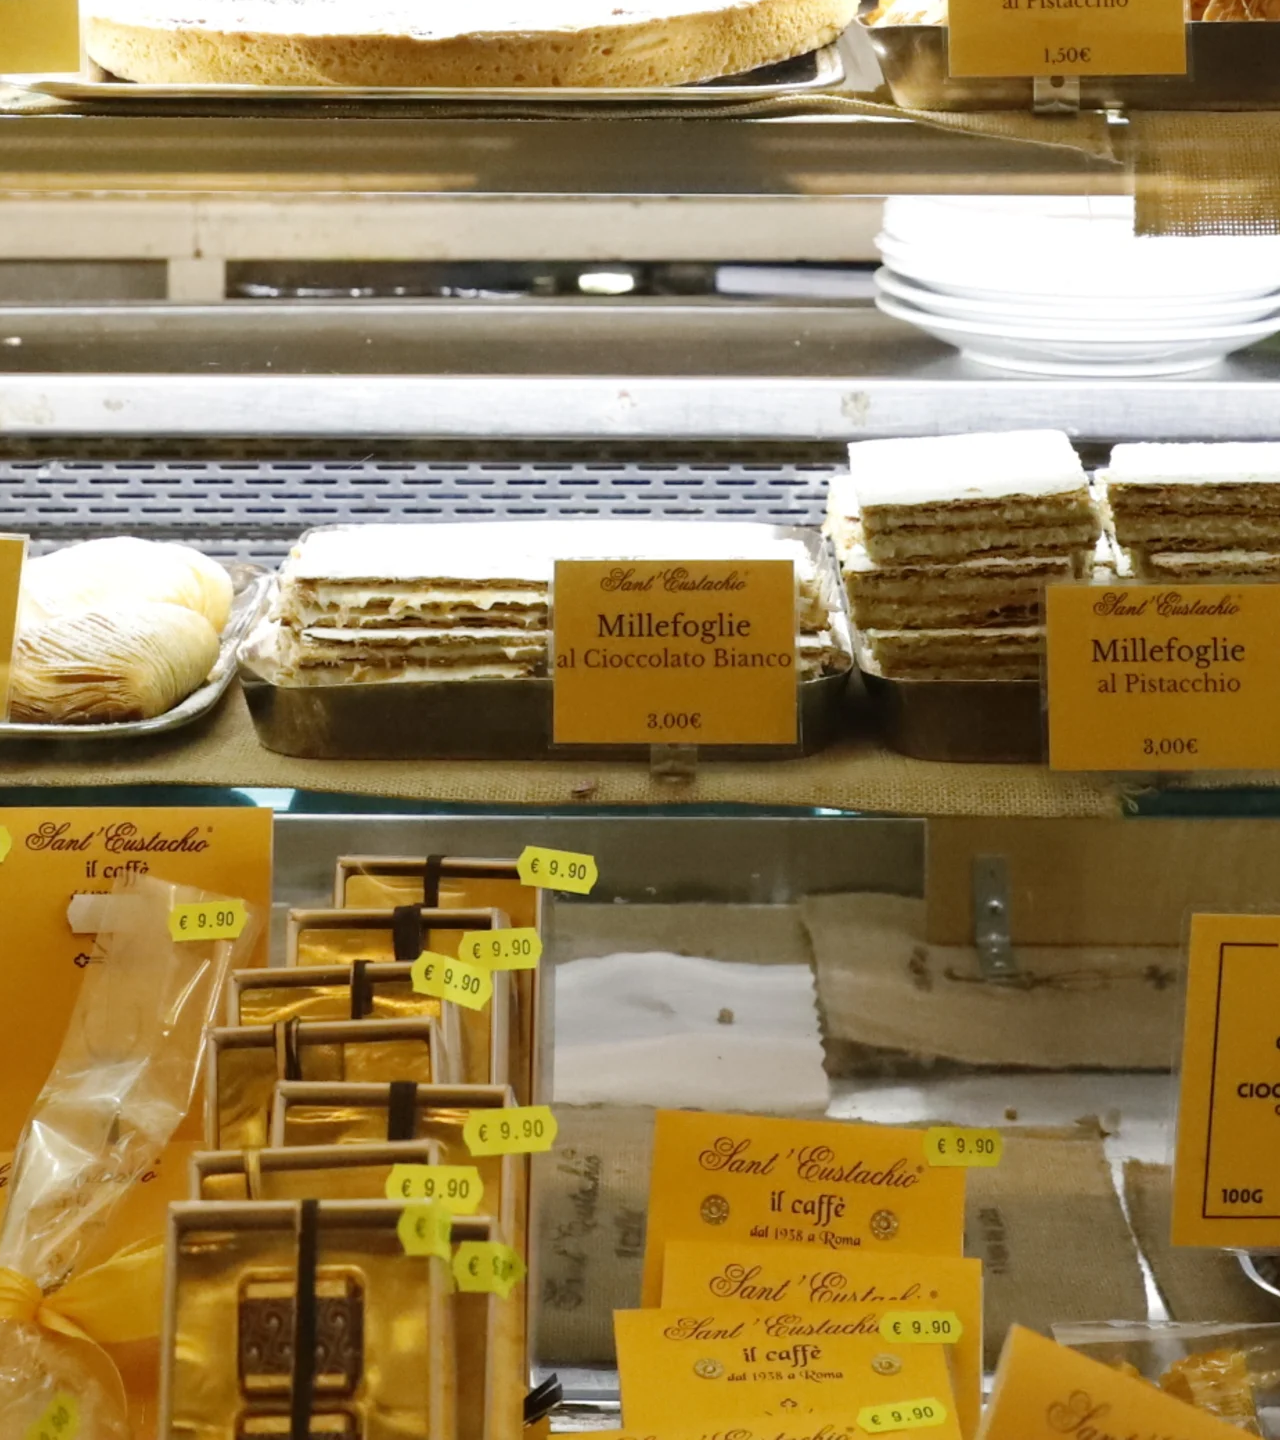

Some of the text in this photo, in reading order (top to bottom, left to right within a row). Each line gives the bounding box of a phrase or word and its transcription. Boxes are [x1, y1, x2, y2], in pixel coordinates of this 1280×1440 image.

[1044, 47, 1091, 64] 1,50€
[596, 612, 751, 644] Millefoglie
[556, 648, 793, 668] al Cioccolato Bianco
[1091, 637, 1245, 669] Millefoglie
[1098, 672, 1241, 694] al Pistacchio
[647, 712, 703, 730] 3,00€
[1143, 738, 1198, 756] 3,00€
[548, 860, 588, 880] 9.90
[197, 910, 236, 929] 9.90
[492, 939, 531, 958] 9.90
[442, 968, 480, 994] 9.90
[499, 1119, 544, 1141] 9.90
[956, 1138, 995, 1155] 9.90
[424, 1178, 470, 1199] 9.90
[1222, 1188, 1263, 1204] 100G
[770, 1191, 846, 1228] il caffè
[749, 1224, 769, 1240] dal
[819, 1230, 862, 1251] Roma
[911, 1320, 952, 1336] 9.90
[764, 1344, 822, 1369] caffè
[799, 1369, 845, 1384] Roma
[871, 1405, 935, 1427] € 9.90
